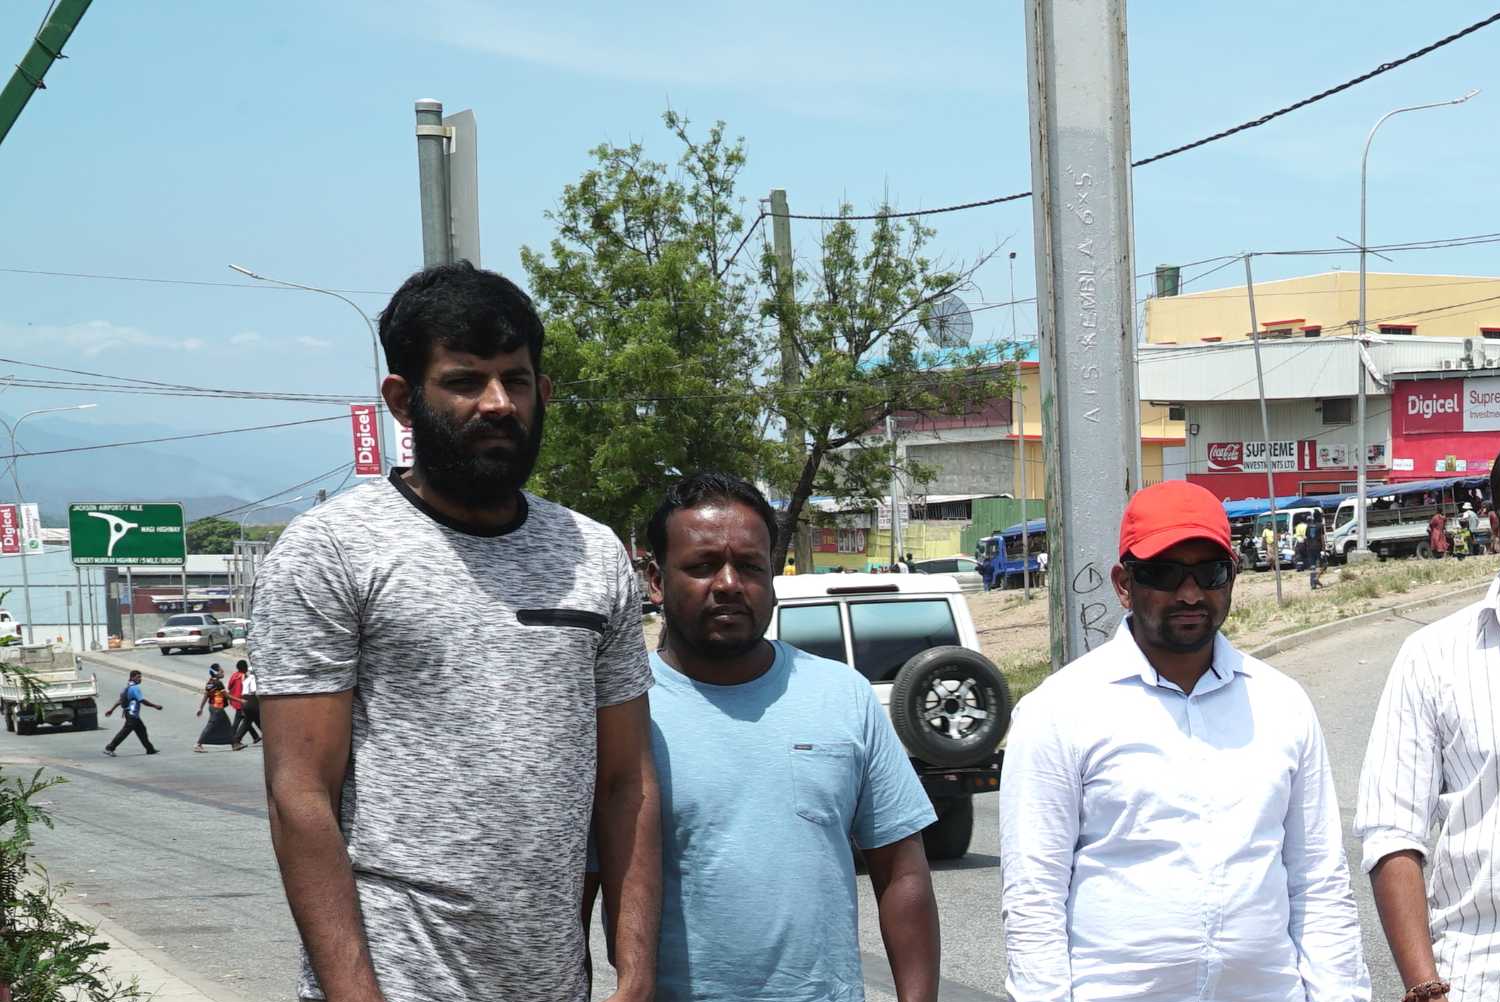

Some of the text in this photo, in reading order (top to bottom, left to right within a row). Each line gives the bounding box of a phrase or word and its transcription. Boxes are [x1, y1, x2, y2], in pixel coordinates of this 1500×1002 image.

[1408, 393, 1460, 419] Digicel
[354, 408, 376, 464] Digicel
[0, 508, 16, 546] Digicel
